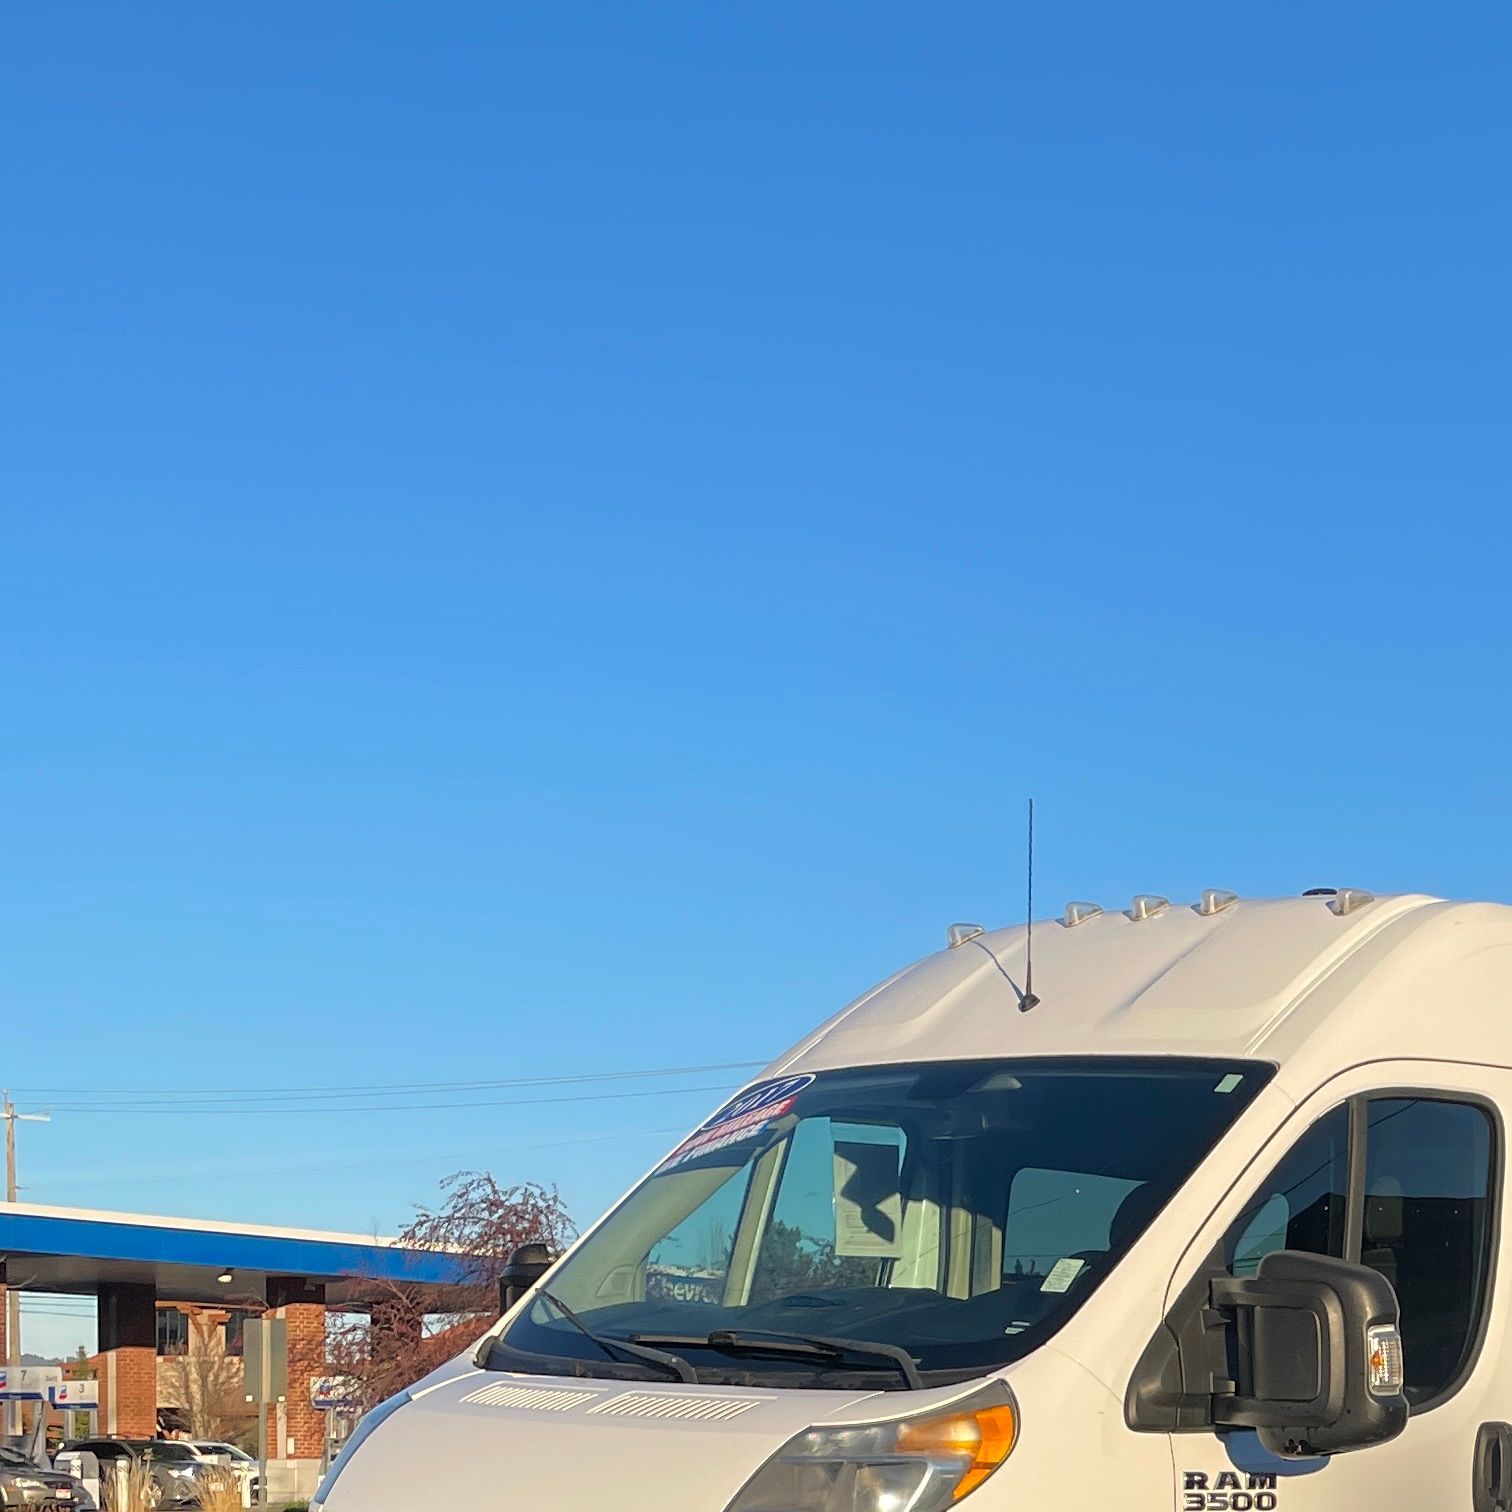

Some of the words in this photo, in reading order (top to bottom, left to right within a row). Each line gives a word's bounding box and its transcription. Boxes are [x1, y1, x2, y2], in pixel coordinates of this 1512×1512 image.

[79, 1384, 85, 1393] 3
[1183, 1471, 1277, 1490] RAM
[1183, 1491, 1277, 1511] 3500
